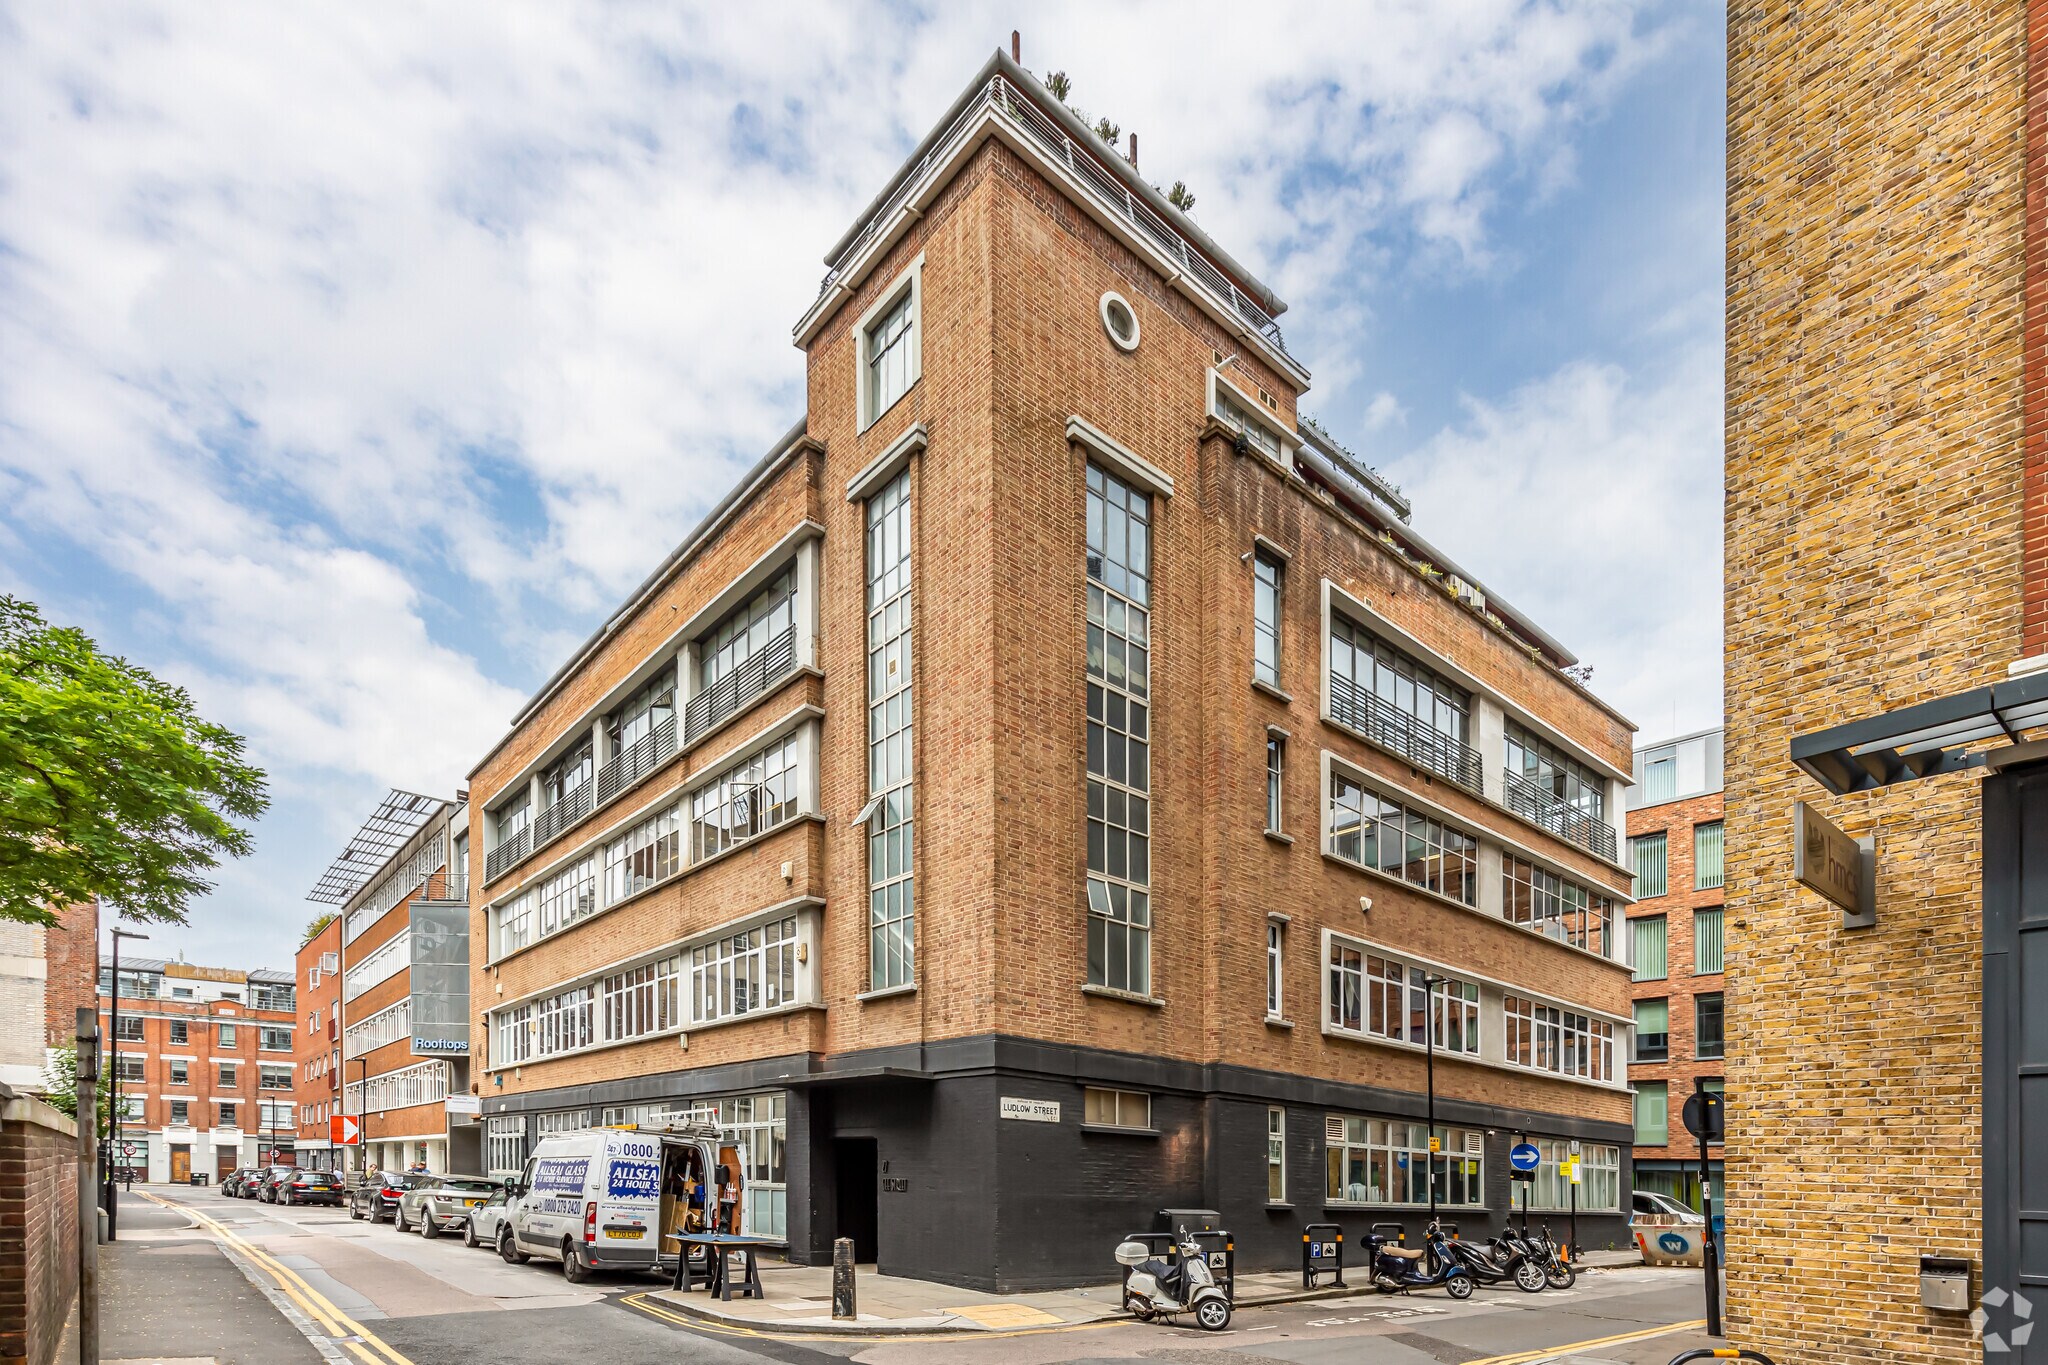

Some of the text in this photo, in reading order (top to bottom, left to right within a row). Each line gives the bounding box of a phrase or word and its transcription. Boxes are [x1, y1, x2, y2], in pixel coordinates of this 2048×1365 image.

[415, 1037, 469, 1052] Rooftops
[1003, 1103, 1058, 1115] LUDLOW STREET
[623, 1143, 653, 1158] 0800
[564, 1165, 587, 1176] GLASS
[612, 1166, 660, 1181] ALLSEA
[611, 1178, 624, 1188] 24
[624, 1179, 651, 1190] HOUR
[544, 1198, 581, 1215] 0800 279 2420
[1313, 1244, 1320, 1257] P
[1664, 1241, 1682, 1252] W
